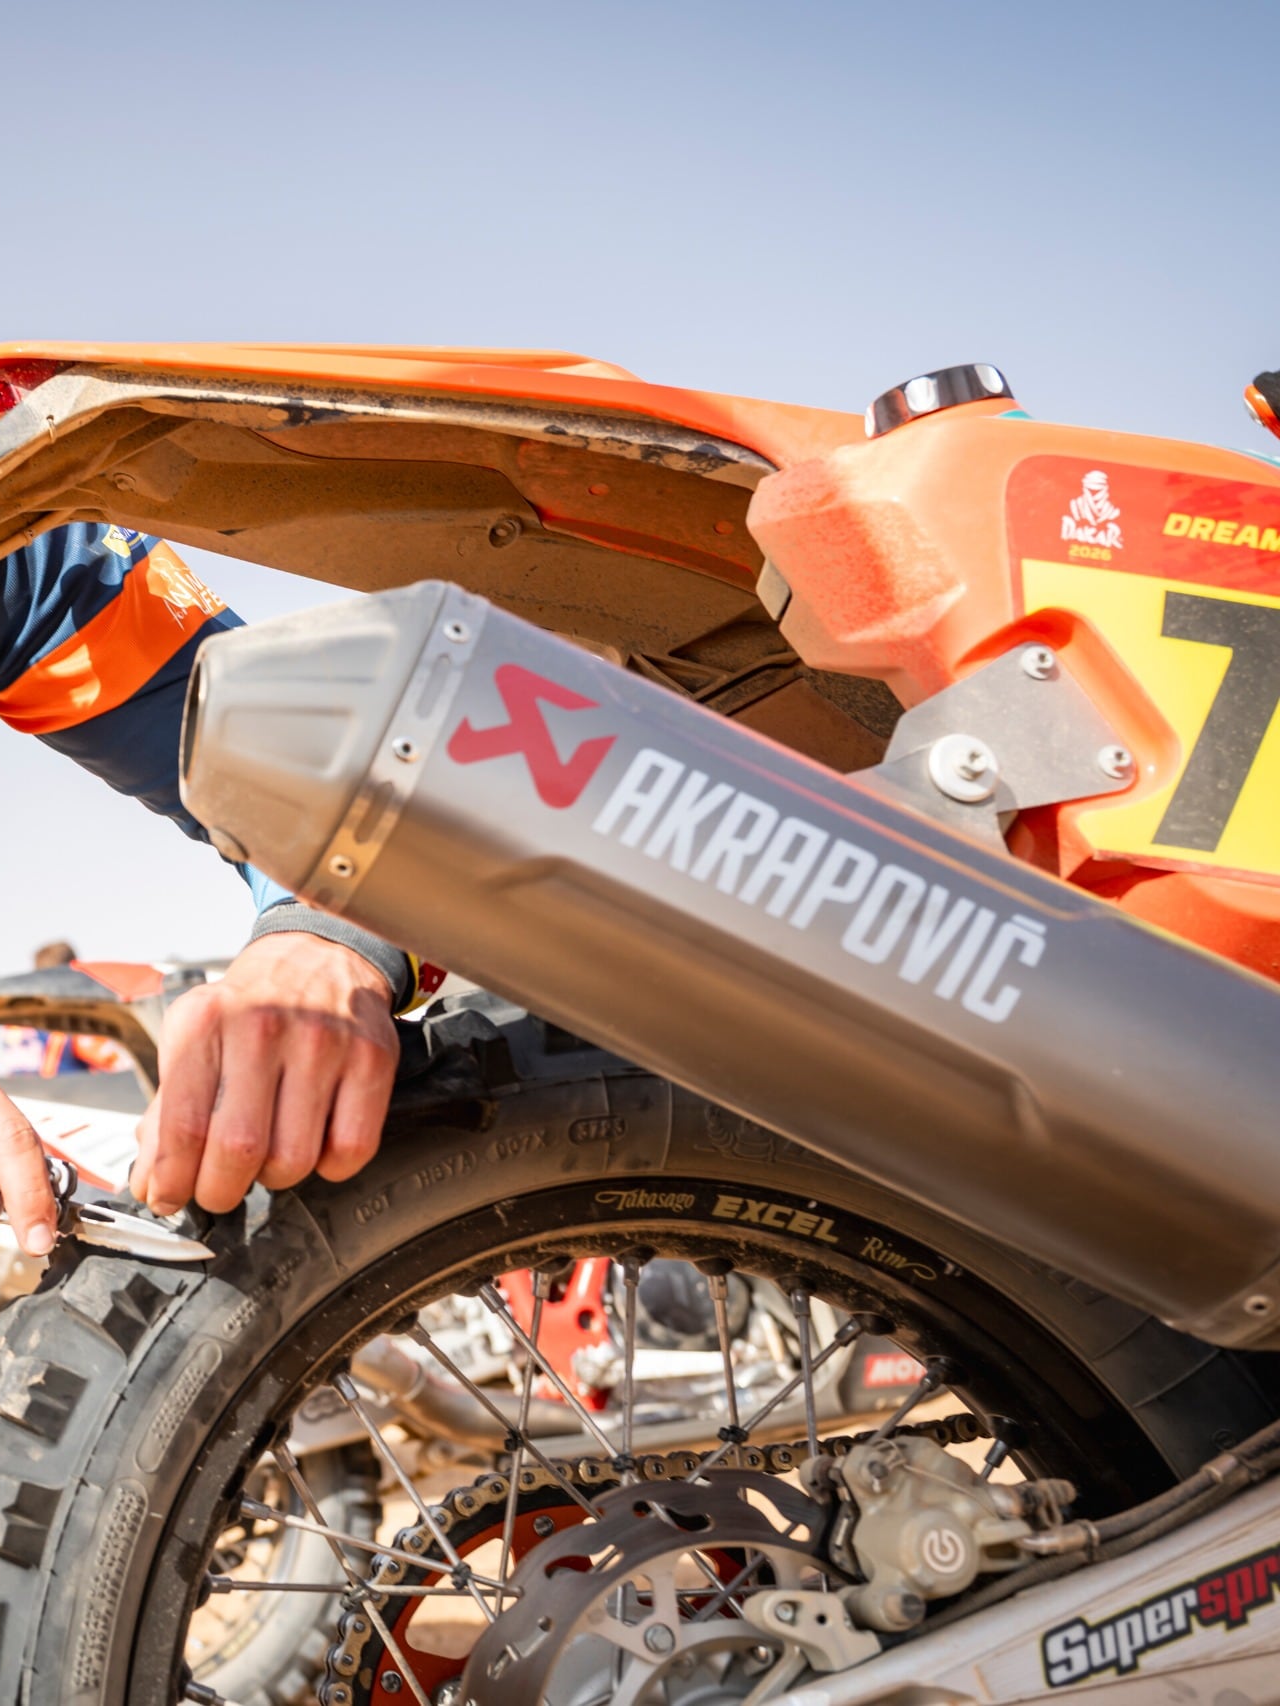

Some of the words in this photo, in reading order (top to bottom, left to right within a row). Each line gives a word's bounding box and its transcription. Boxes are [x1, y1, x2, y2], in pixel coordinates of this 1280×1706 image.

[1069, 544, 1112, 561] 2026
[1151, 590, 1280, 853] 7
[595, 1189, 695, 1212] Takasago
[712, 1195, 838, 1244] EXCEL
[863, 1236, 936, 1281] Rim
